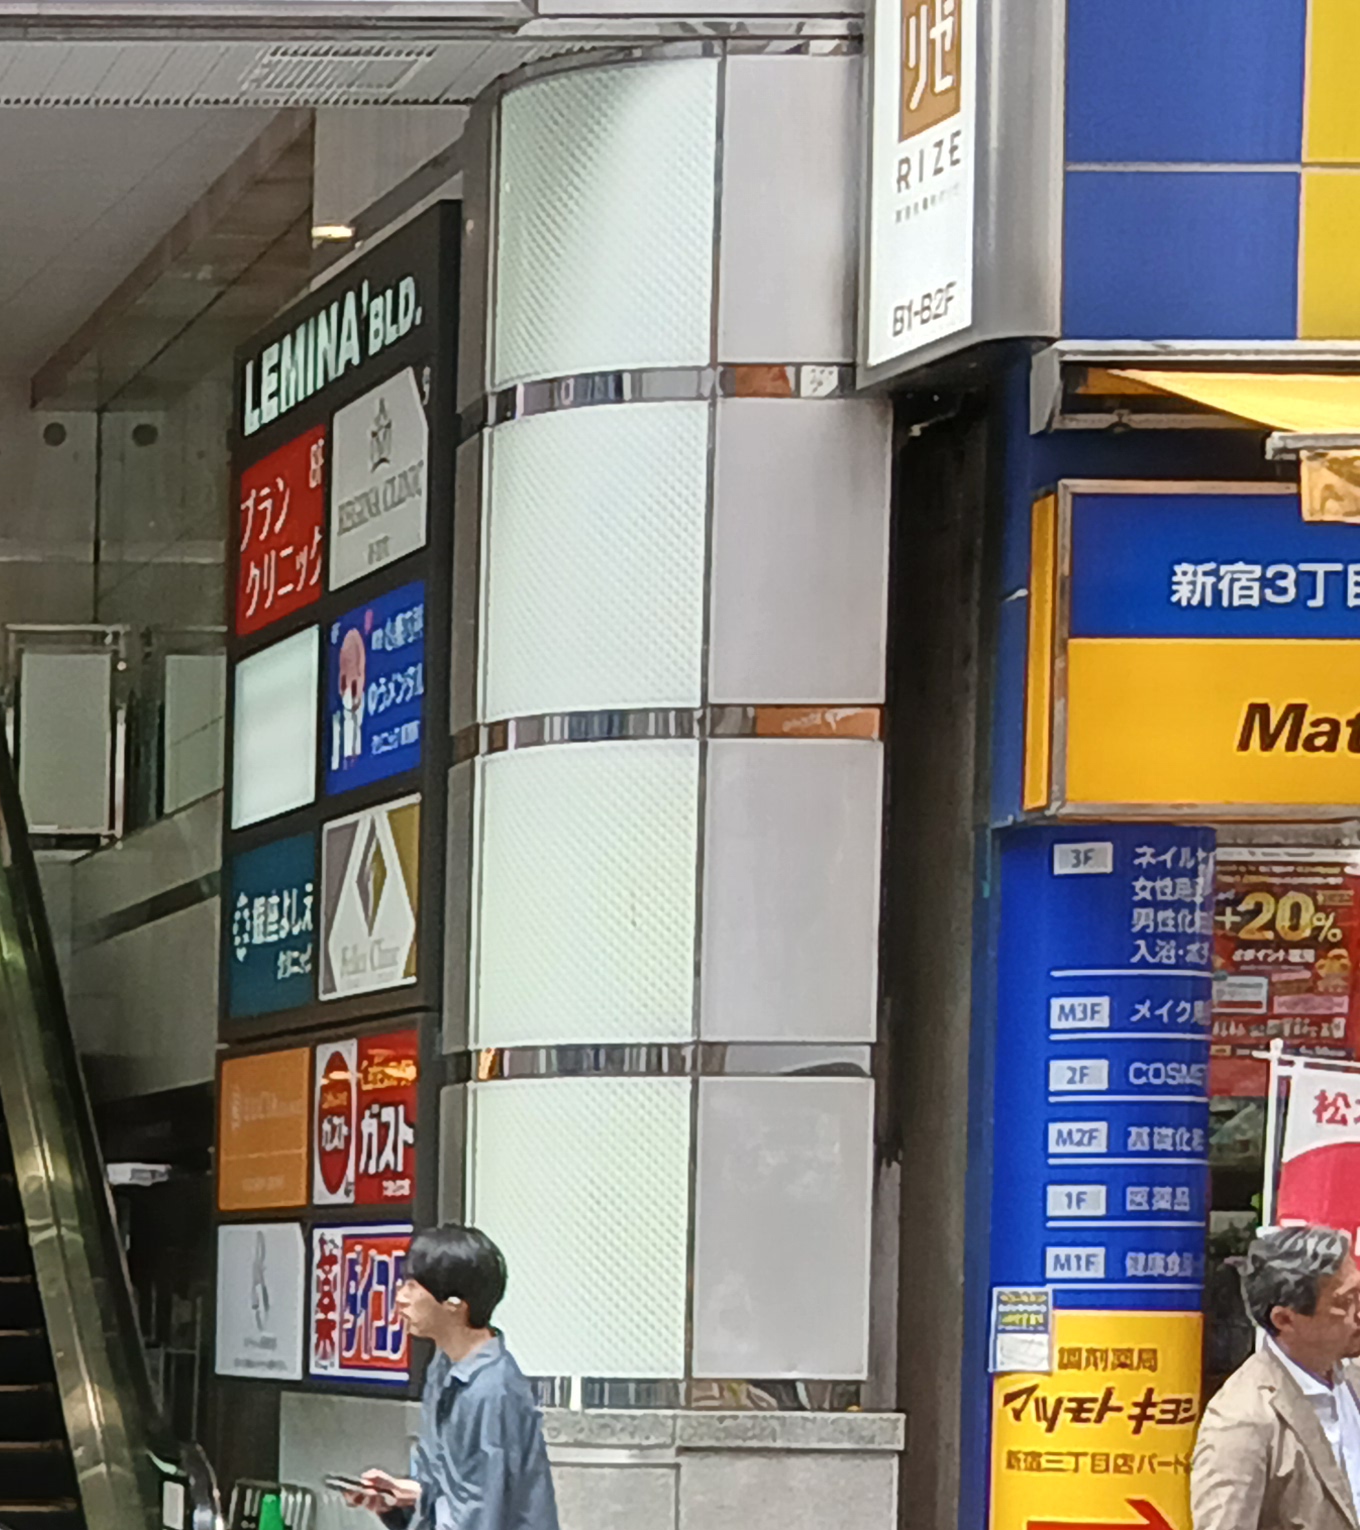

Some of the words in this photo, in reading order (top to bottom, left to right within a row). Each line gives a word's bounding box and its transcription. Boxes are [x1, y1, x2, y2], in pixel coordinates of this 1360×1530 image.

[896, 129, 962, 193] RIZE
[892, 281, 957, 337] B1-B2F
[1070, 850, 1094, 869] 3F
[1057, 1003, 1102, 1022] M3F
[1066, 1066, 1090, 1086] 2F
[1313, 1089, 1360, 1127] 松
[359, 1104, 415, 1174] ガスト
[1055, 1128, 1100, 1146] M2F
[1064, 1191, 1088, 1211] 1F
[1053, 1253, 1097, 1272] M1F
